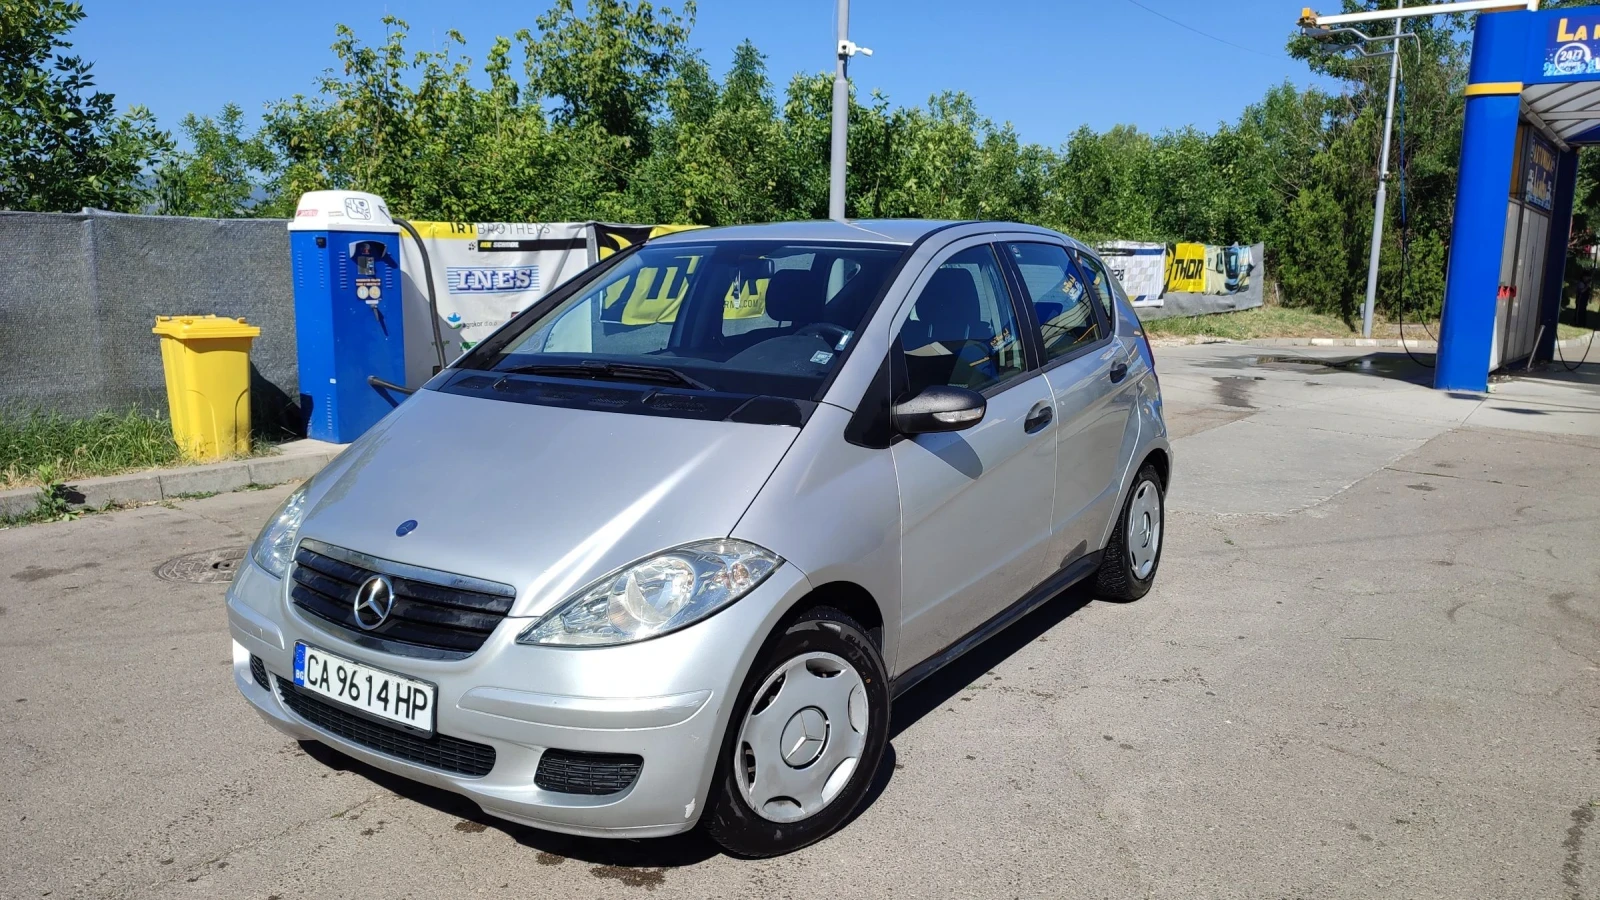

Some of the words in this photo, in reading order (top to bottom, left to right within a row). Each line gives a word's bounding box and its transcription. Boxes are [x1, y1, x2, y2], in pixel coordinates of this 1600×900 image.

[456, 269, 533, 291] INES
[1173, 258, 1204, 280] THOR
[295, 669, 305, 681] BG
[307, 654, 331, 693] CA
[336, 664, 390, 712] 9614
[394, 682, 428, 721] HP
